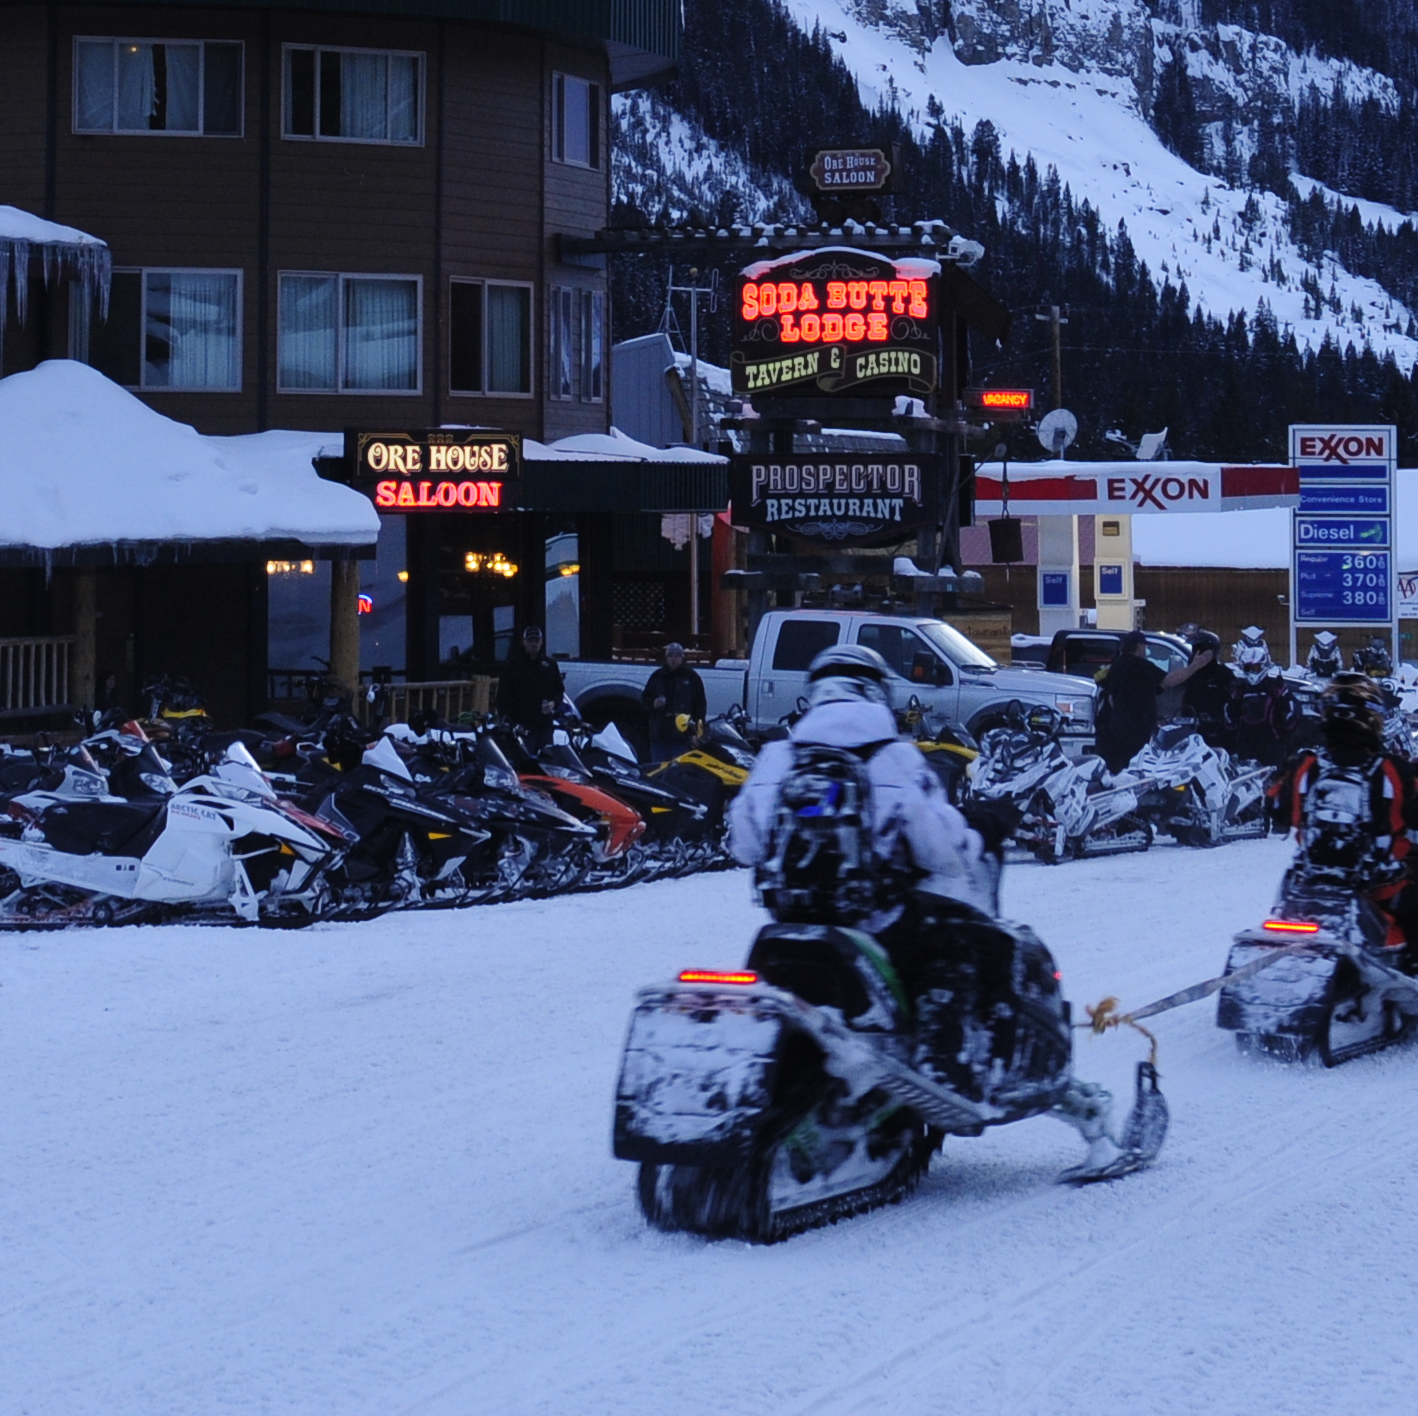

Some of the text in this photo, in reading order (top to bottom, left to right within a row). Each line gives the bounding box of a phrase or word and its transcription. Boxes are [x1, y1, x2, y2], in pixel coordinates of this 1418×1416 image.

[824, 155, 876, 169] ORE HOUSE
[824, 171, 876, 184] SALOON
[742, 281, 927, 320] SODA BUTTE
[780, 312, 888, 342] LODGE
[745, 347, 921, 388] TAVERN & CASINO
[983, 392, 1029, 406] VACANCY
[1300, 433, 1384, 465] EXXON
[367, 442, 509, 476] ORE HOUSE
[376, 480, 502, 507] SALOON
[750, 464, 923, 507] PROSPECTOR
[1107, 473, 1210, 511] EXXON
[1300, 494, 1383, 504] Convenience Store
[765, 498, 904, 522] RESTAURANT
[1300, 524, 1355, 540] Diesel
[1342, 555, 1377, 569] 360
[1045, 575, 1063, 584] Self
[1101, 567, 1119, 575] Self
[1342, 573, 1377, 587] 370
[1342, 591, 1377, 605] 380
[171, 803, 199, 814] ARCTIC
[201, 809, 217, 821] CAT
